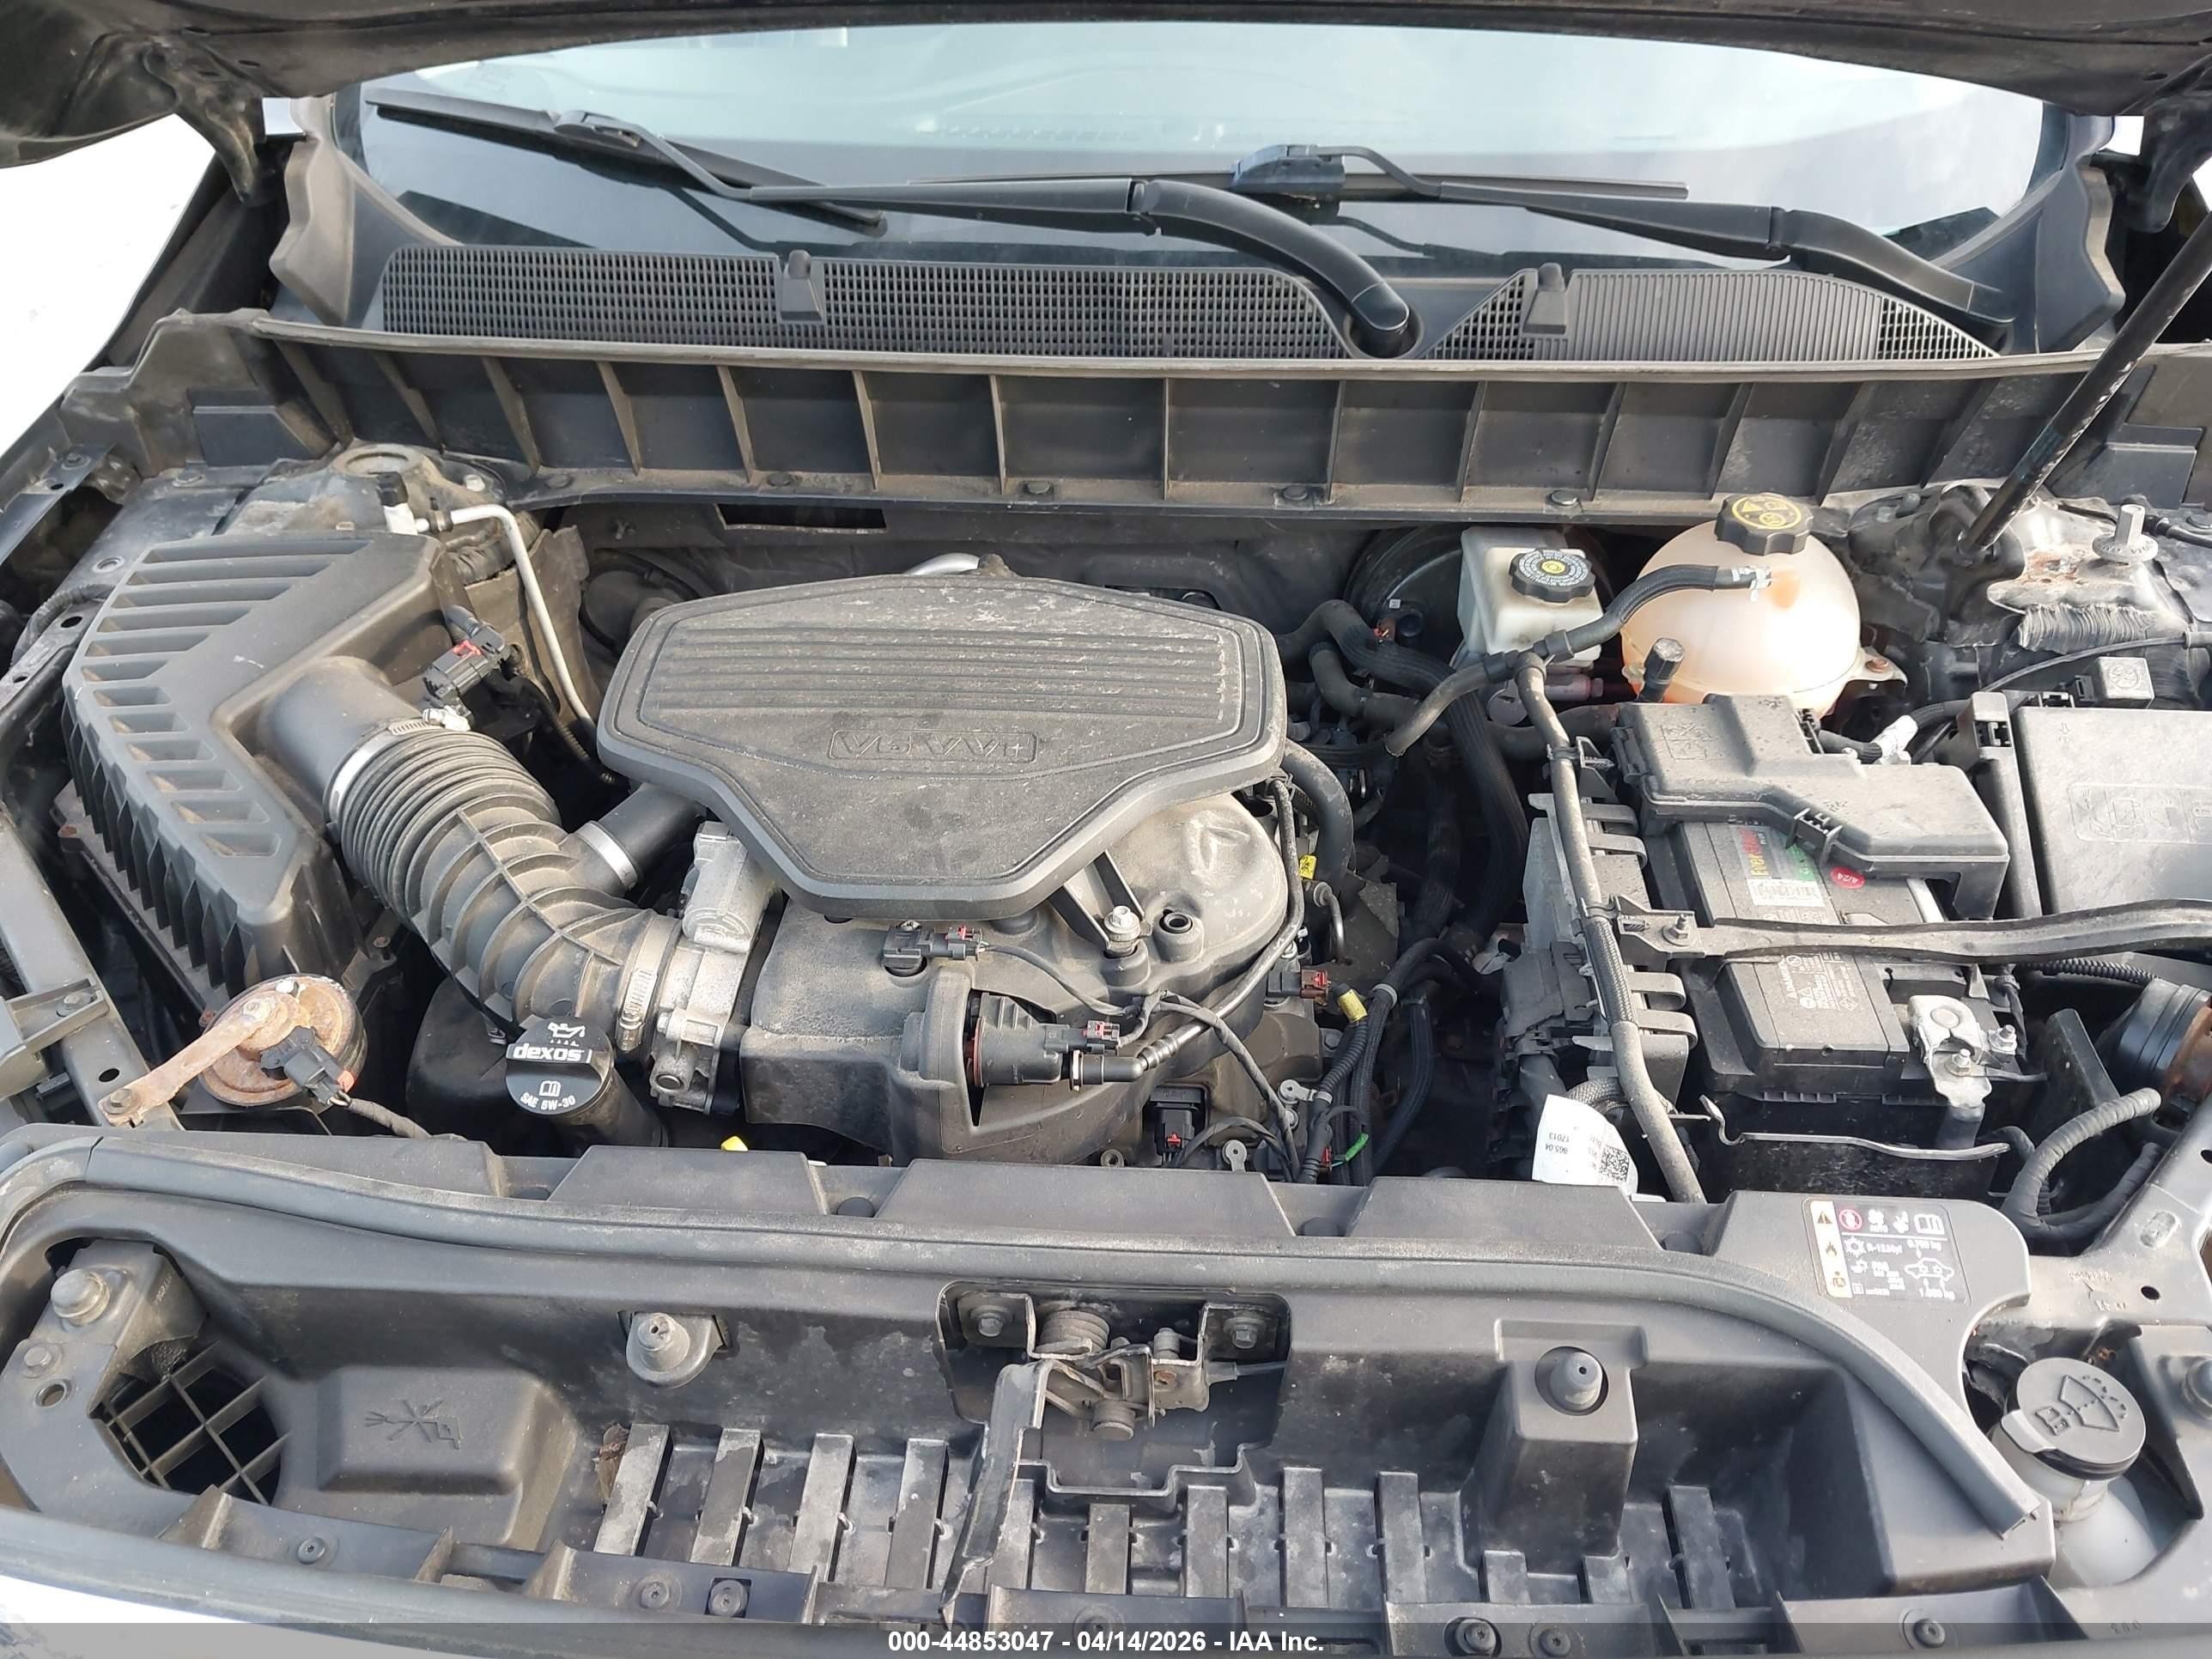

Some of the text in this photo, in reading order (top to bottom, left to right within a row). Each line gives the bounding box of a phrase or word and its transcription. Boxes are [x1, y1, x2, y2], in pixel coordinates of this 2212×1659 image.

[514, 1043, 583, 1062] dexos
[520, 1092, 576, 1110] SAE 5W-30
